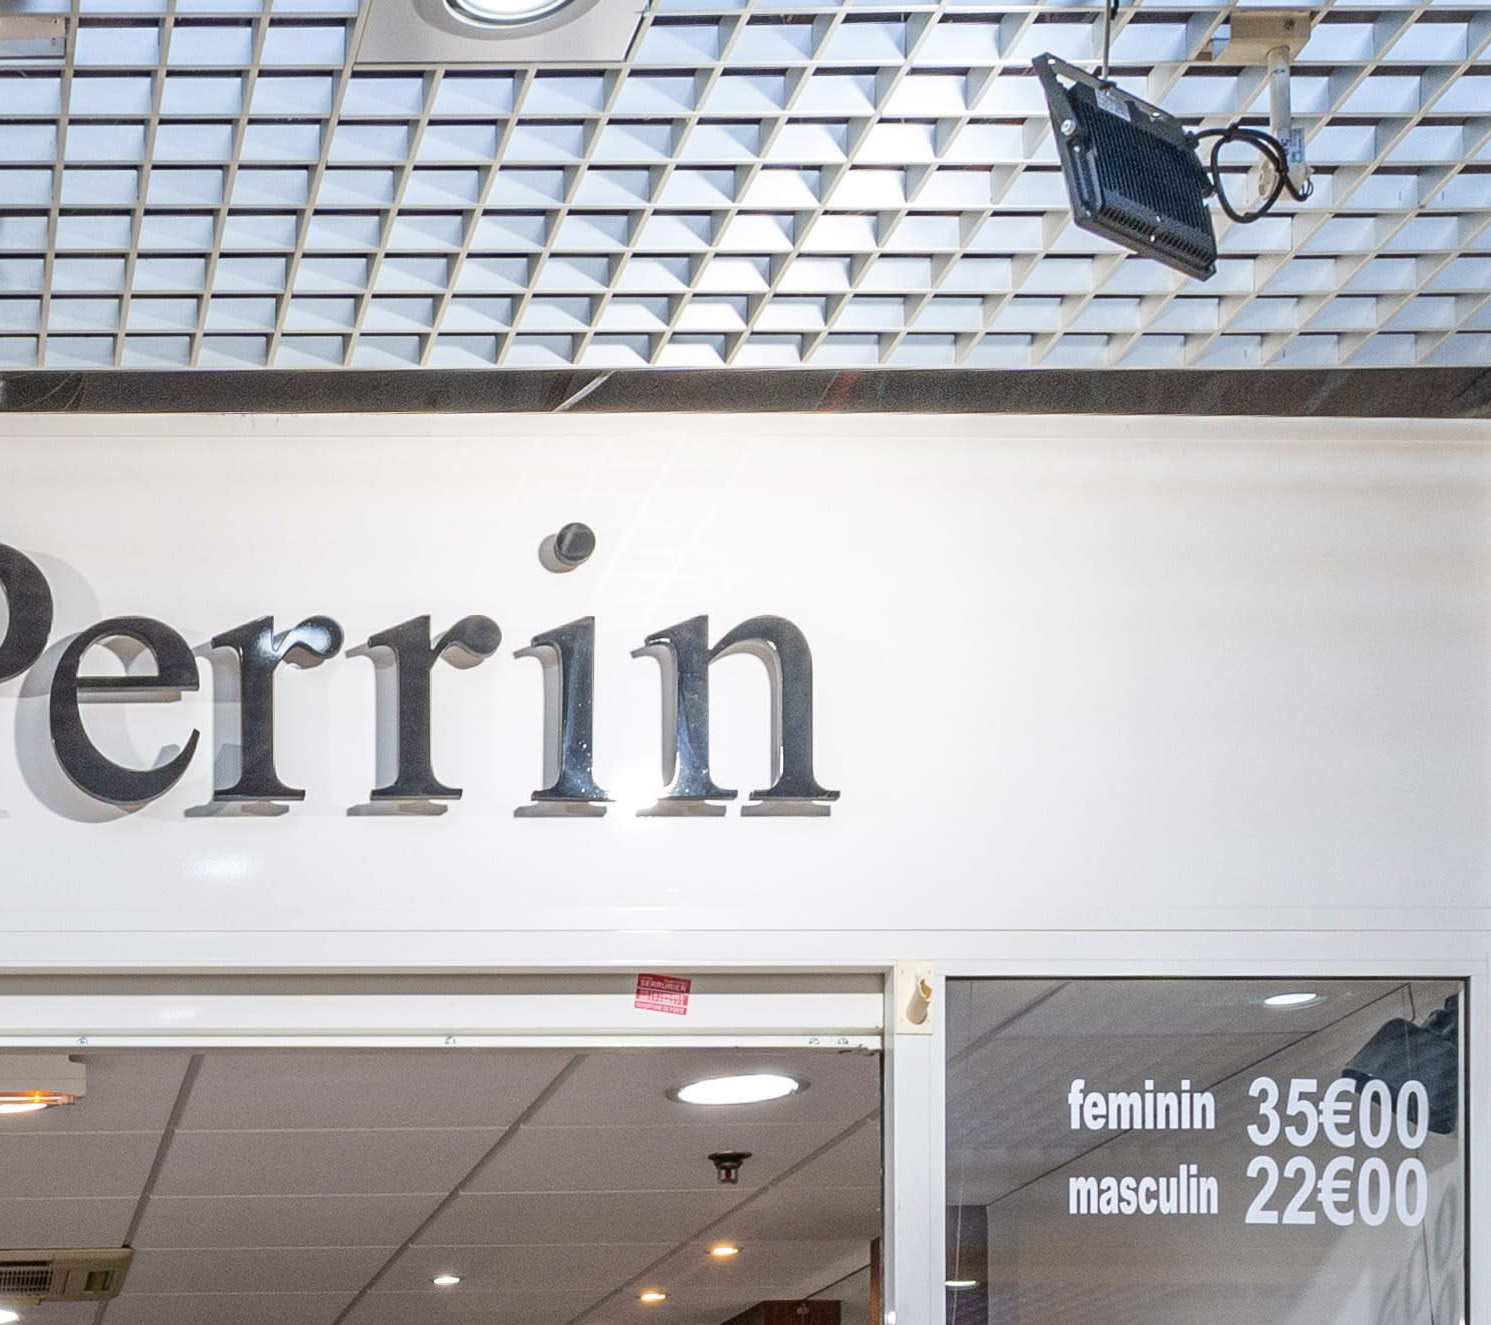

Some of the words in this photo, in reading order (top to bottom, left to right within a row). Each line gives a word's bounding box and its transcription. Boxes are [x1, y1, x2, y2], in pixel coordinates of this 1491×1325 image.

[1068, 1080, 1215, 1130] feminin
[1247, 1077, 1429, 1149] 35€00
[1069, 1164, 1218, 1215] masculin
[1245, 1156, 1428, 1226] 22€00
